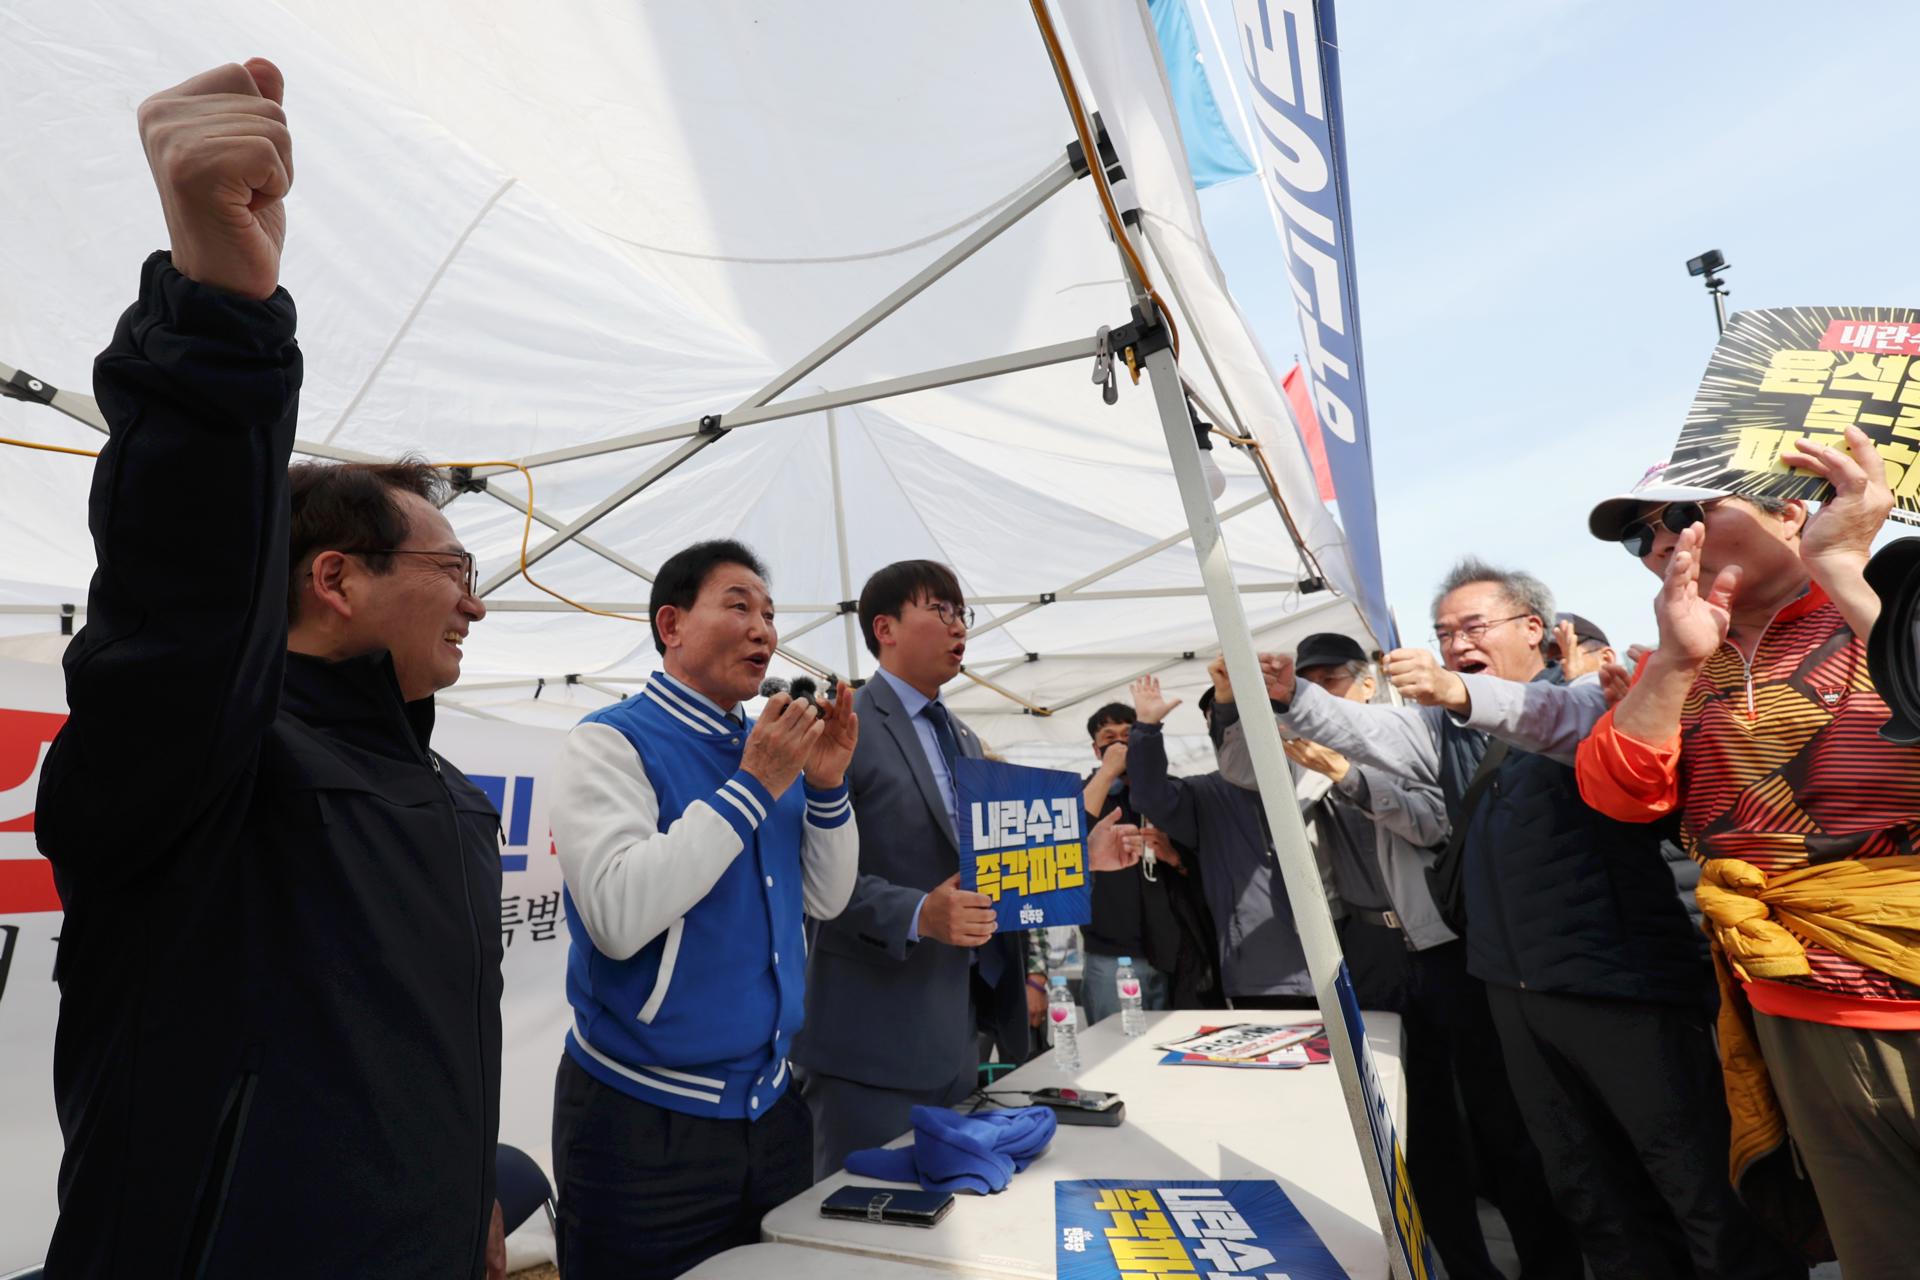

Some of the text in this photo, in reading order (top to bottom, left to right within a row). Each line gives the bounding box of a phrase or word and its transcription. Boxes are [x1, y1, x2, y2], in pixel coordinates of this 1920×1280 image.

[1759, 350, 1920, 405] 윤석
[971, 797, 1080, 851] 내란수괴
[976, 842, 1084, 902] 즉각파면
[501, 891, 566, 948] 특별
[1094, 1189, 1203, 1280] 즉각파
[1157, 1188, 1293, 1280] 내란수
